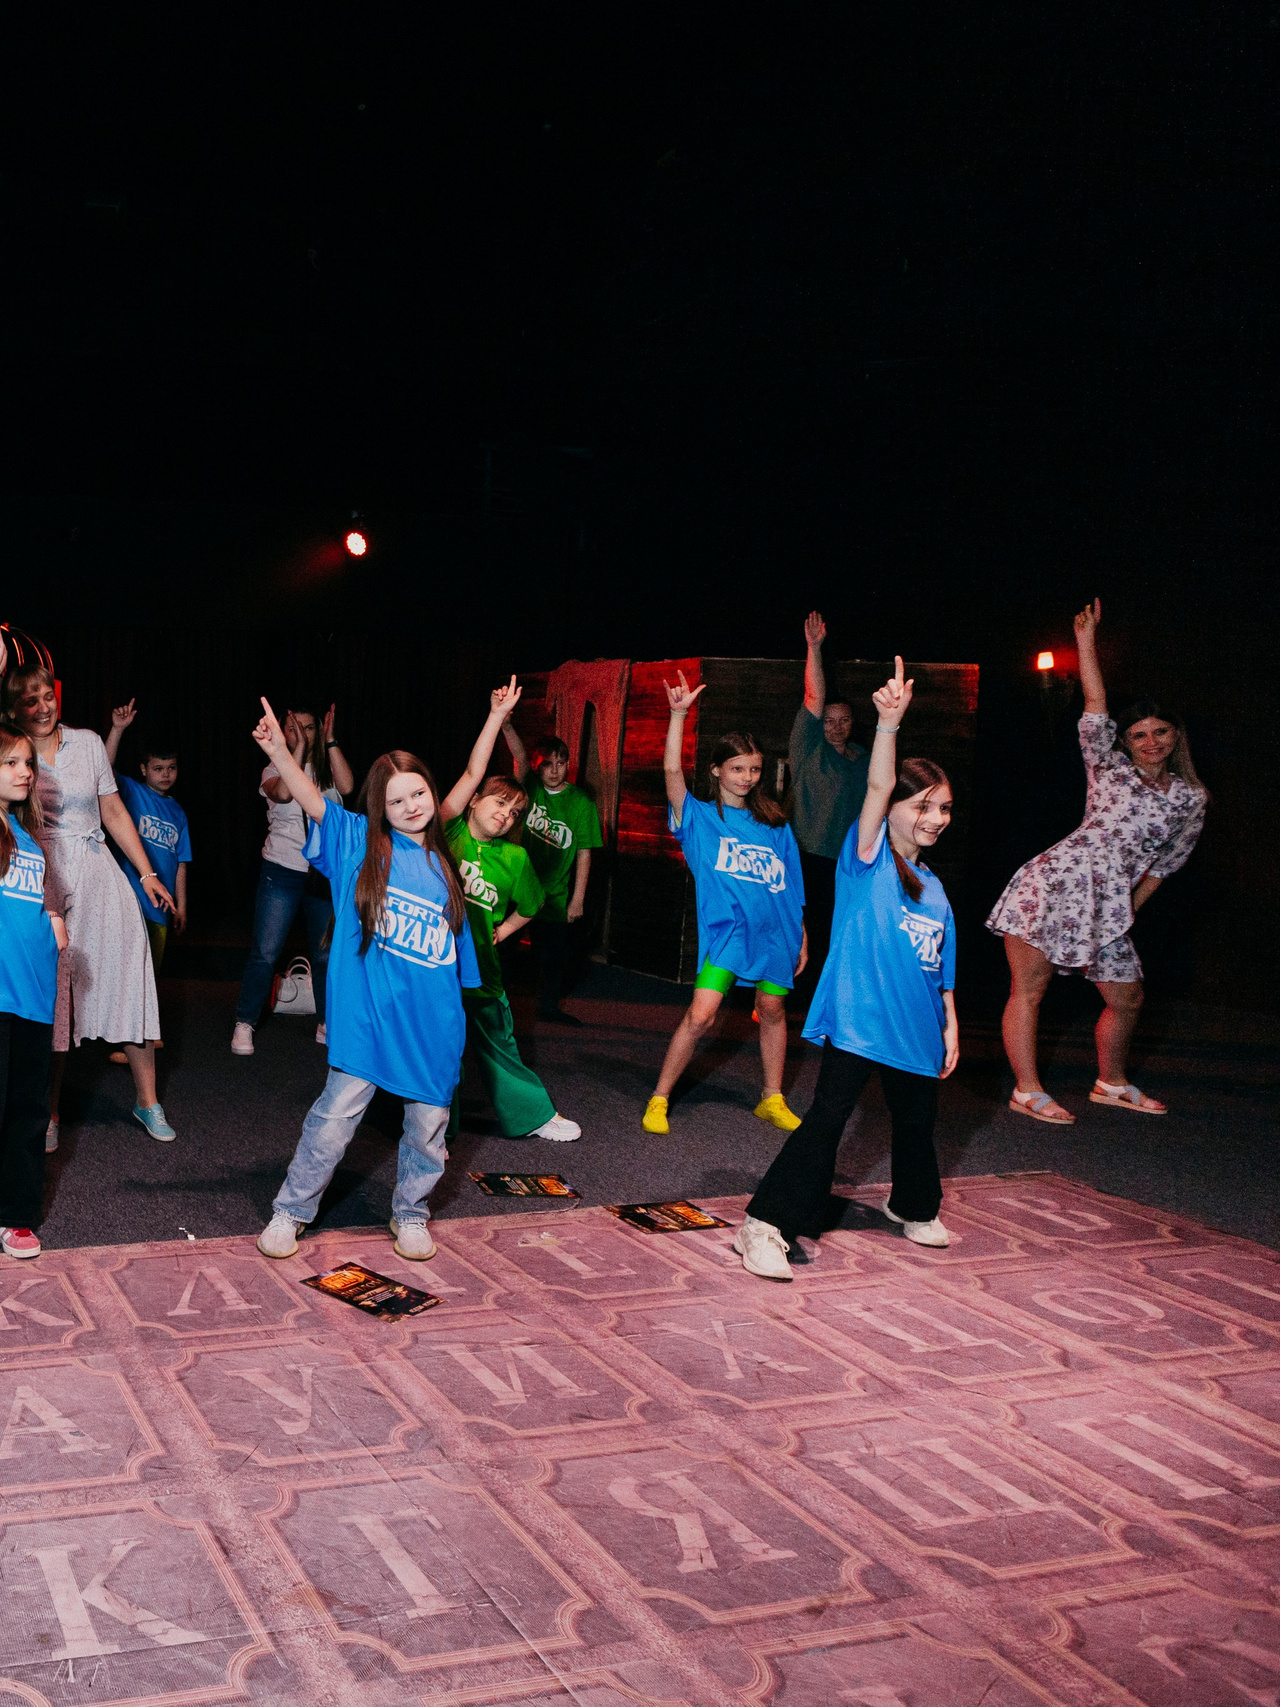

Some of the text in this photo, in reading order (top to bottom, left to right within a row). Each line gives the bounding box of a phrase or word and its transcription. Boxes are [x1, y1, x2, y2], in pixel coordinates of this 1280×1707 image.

[370, 909, 457, 966] OYARD
[388, 896, 438, 923] FORT
[166, 1265, 262, 1316] Л
[517, 1229, 638, 1279] Е
[995, 1196, 1113, 1232] В
[227, 1361, 319, 1436] У
[430, 1336, 601, 1407] И
[648, 1316, 811, 1382] Х
[830, 1297, 1028, 1358] Ц
[1031, 1281, 1173, 1333] Ф
[27, 1537, 207, 1661] К
[607, 1467, 799, 1574] Я
[820, 1436, 1103, 1532] Щ
